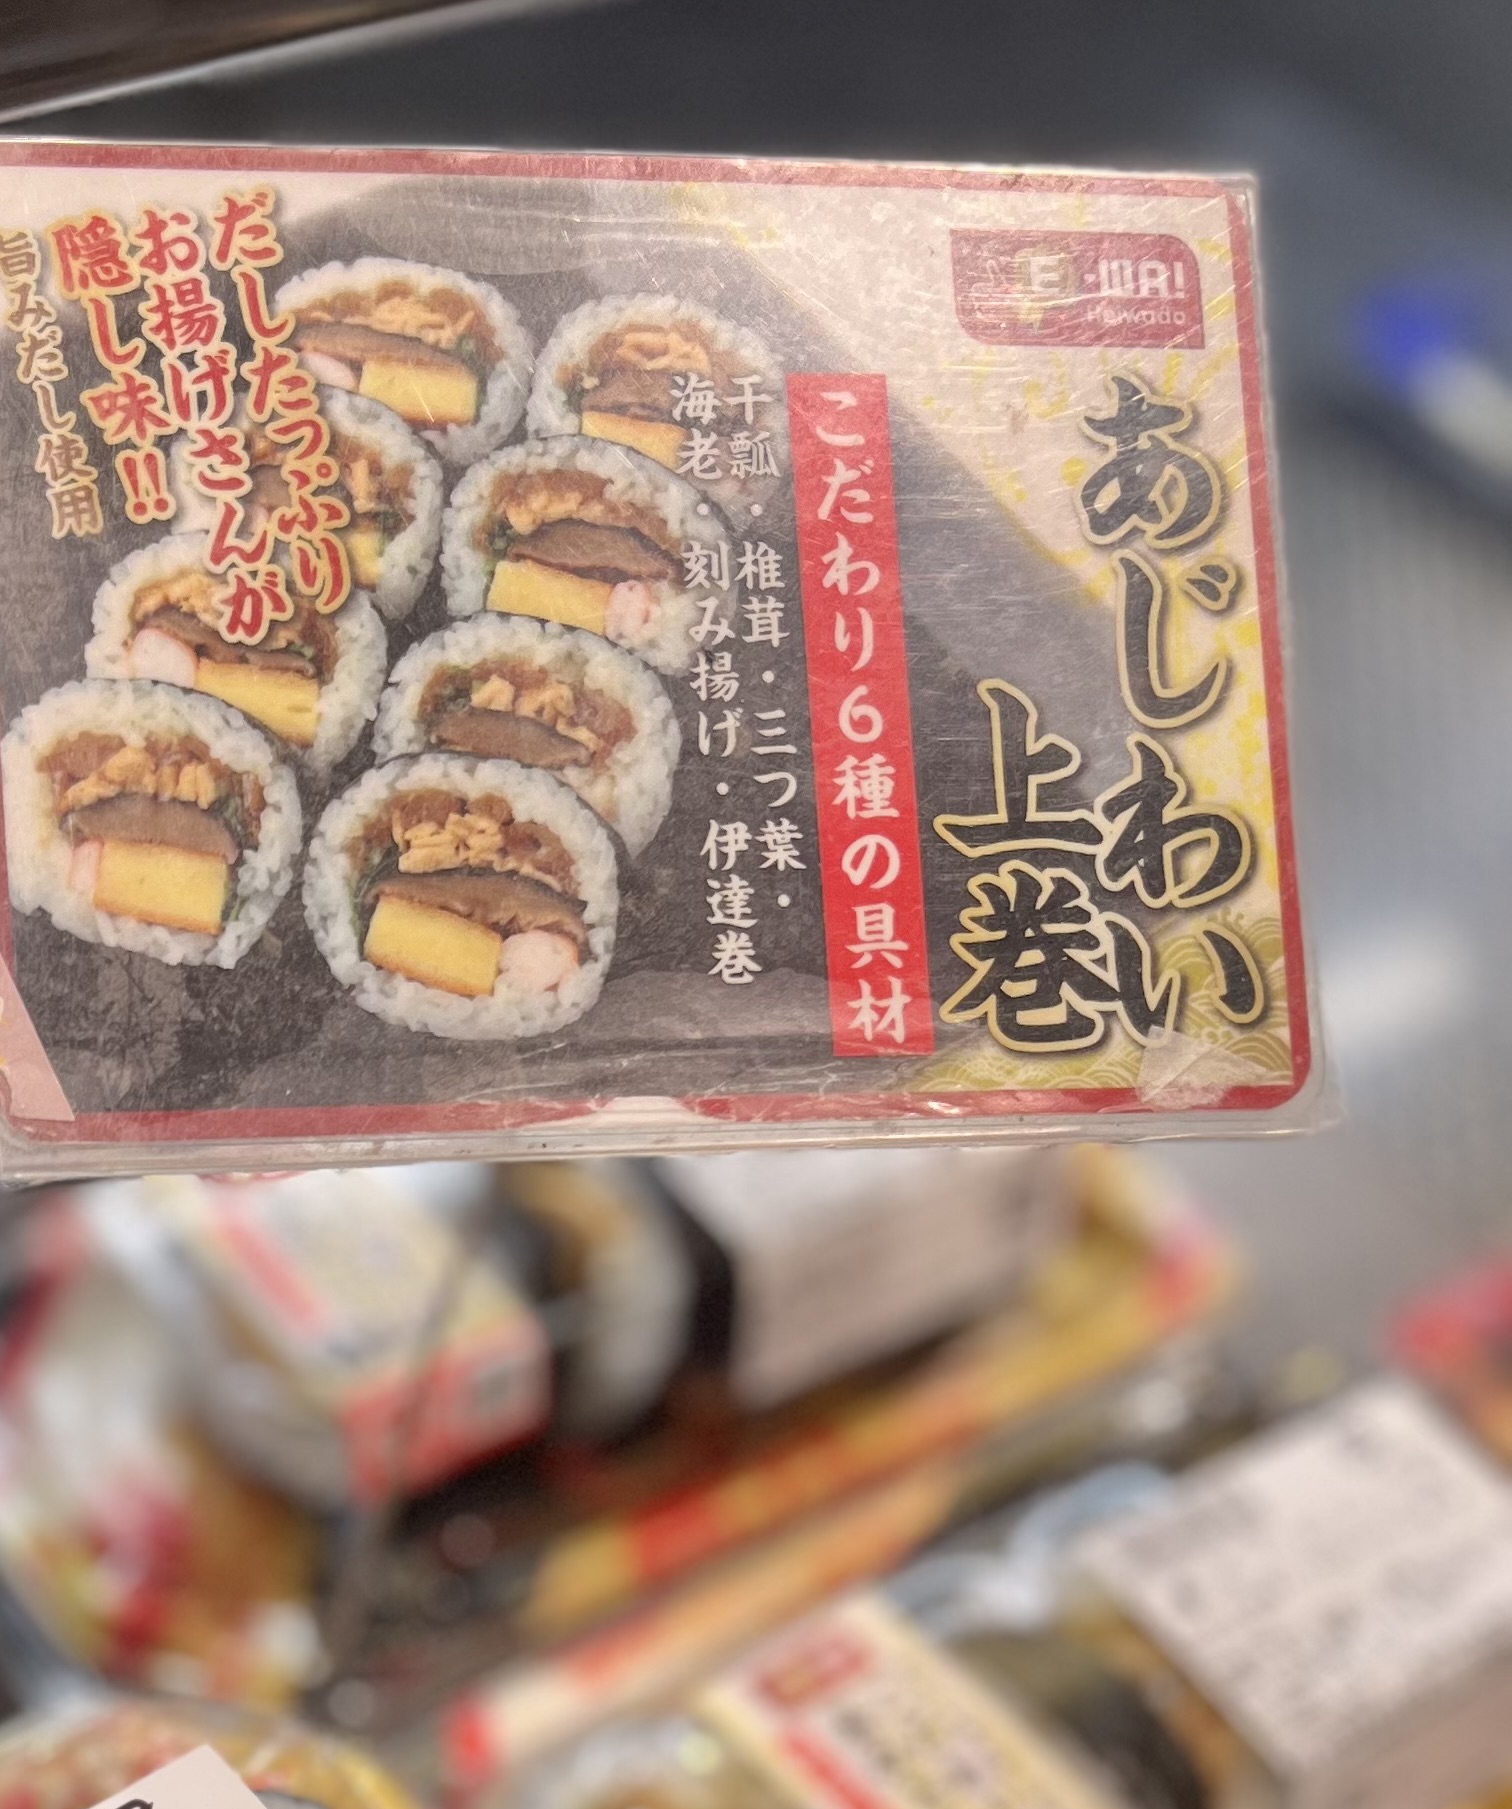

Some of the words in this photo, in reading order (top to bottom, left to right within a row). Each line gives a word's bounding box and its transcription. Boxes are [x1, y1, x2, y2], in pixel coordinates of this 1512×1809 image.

[138, 210, 288, 640] お揚げさんが
[212, 188, 349, 612] だしたっぷり
[815, 390, 914, 1045] こだわり6種の具材
[933, 680, 1108, 1052] 上巻
[1080, 373, 1268, 1048] あじわい
